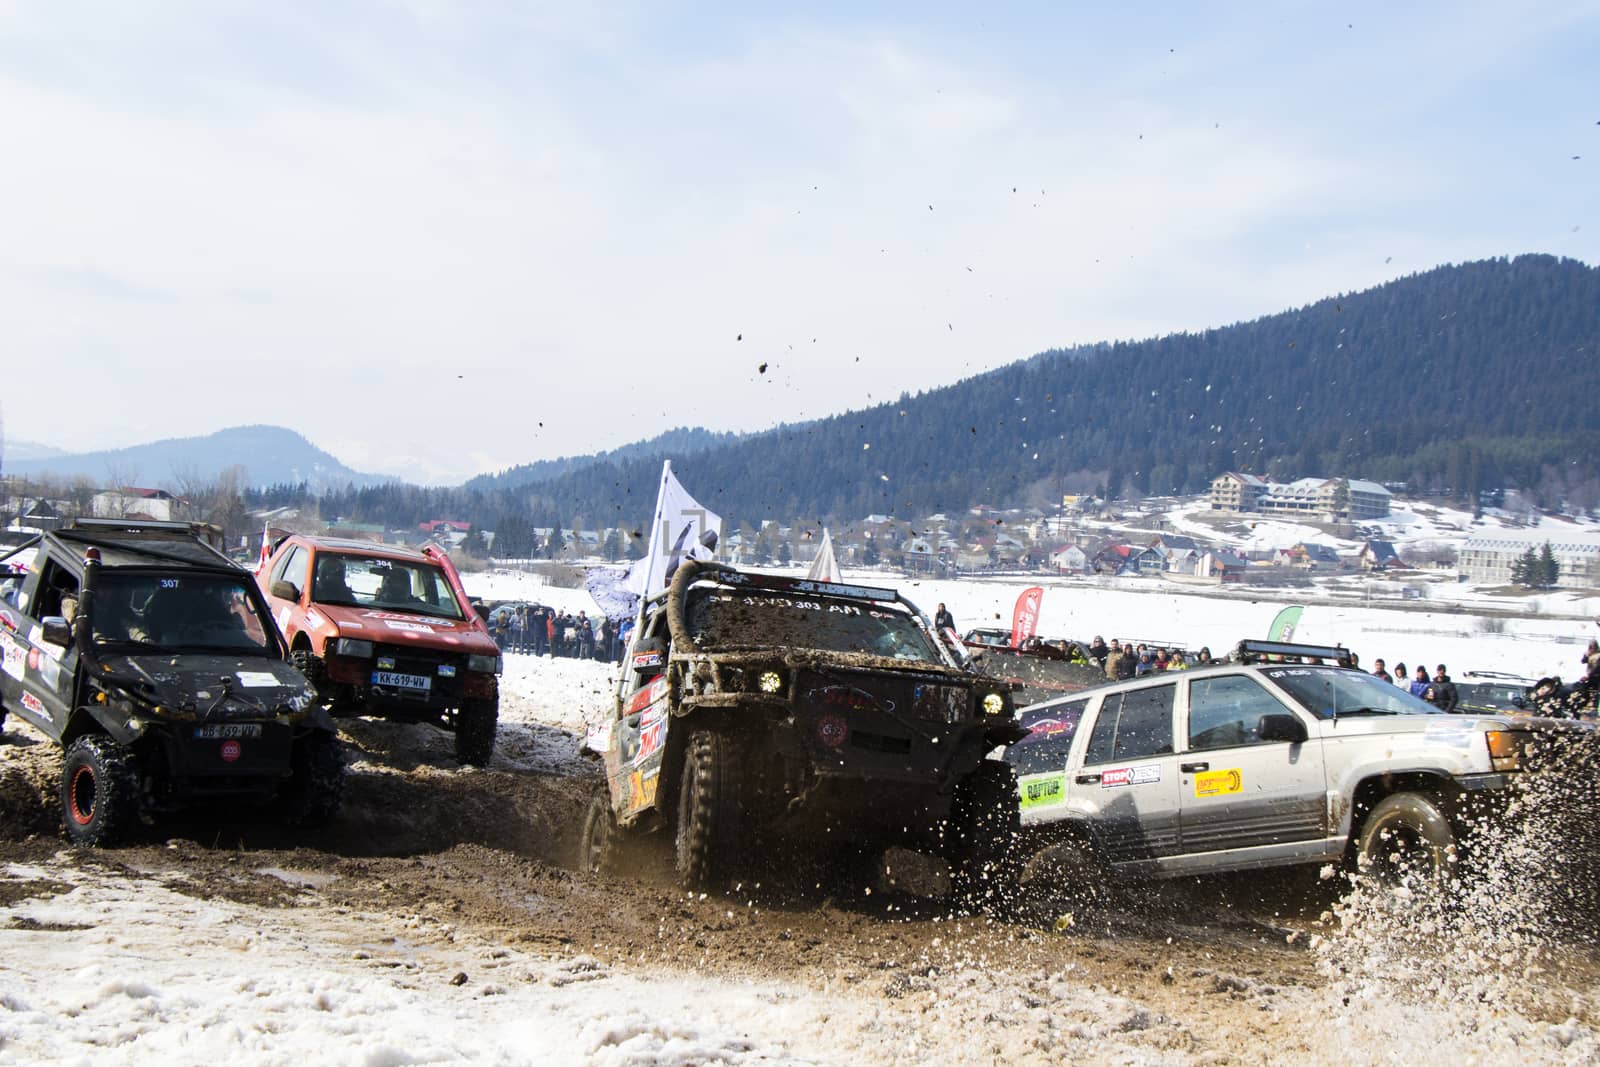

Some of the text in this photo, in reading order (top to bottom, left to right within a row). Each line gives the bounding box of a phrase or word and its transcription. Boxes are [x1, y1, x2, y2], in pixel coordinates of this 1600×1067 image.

[161, 578, 179, 589] 307
[795, 601, 822, 611] 303
[379, 672, 425, 688] KK-619-WW
[1104, 771, 1126, 782] STOP
